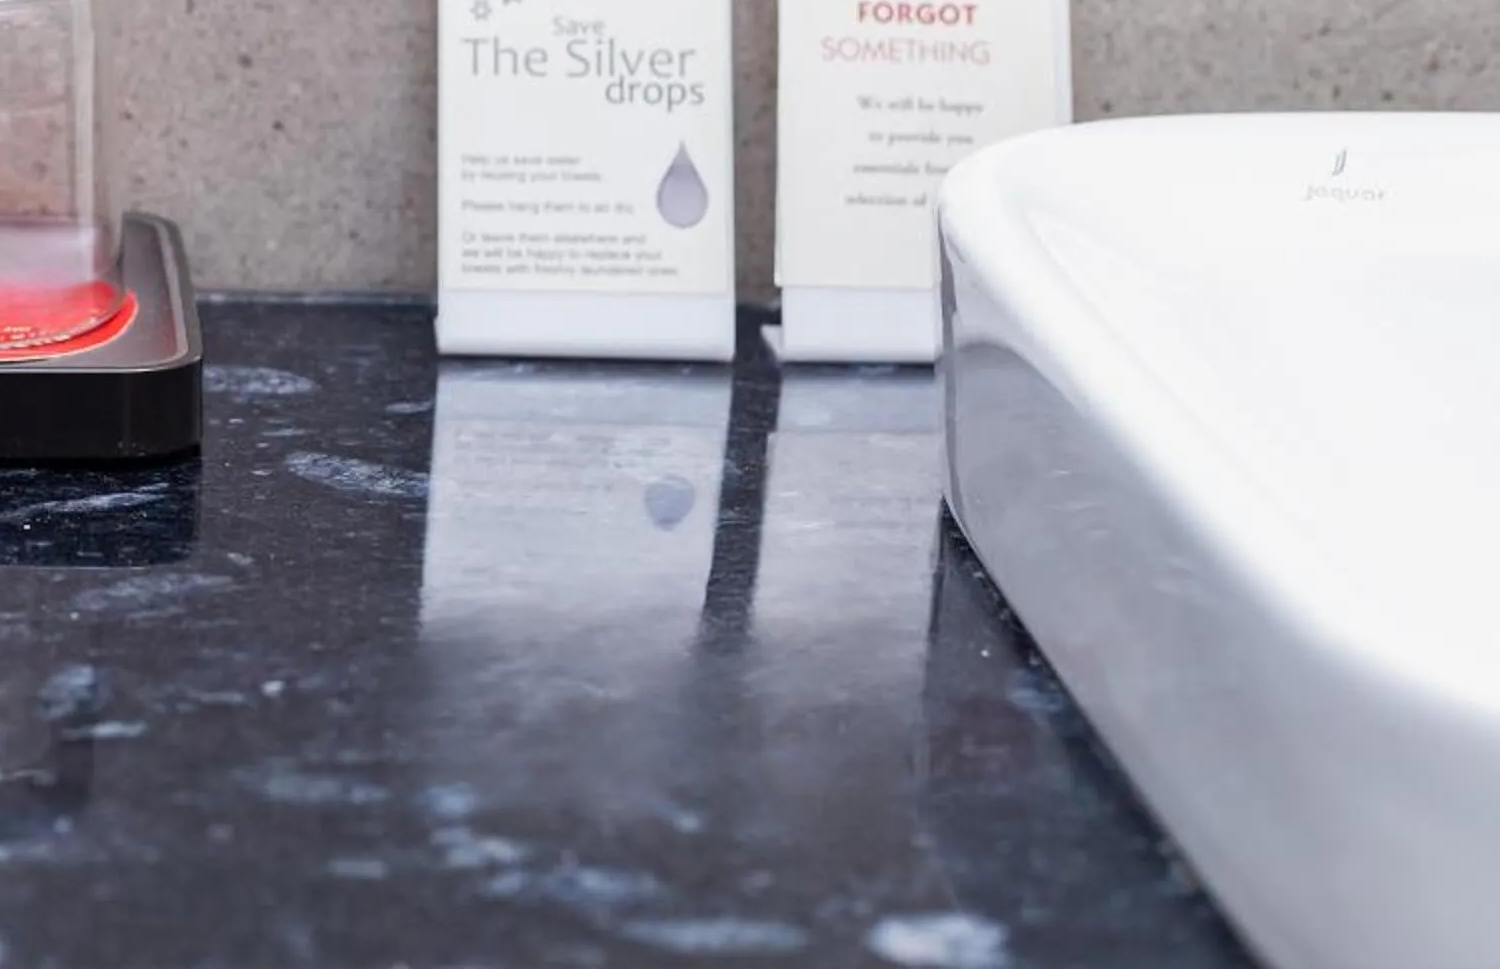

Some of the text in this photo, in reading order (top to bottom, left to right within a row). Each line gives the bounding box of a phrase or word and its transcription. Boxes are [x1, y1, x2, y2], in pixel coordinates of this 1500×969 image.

[552, 15, 605, 36] Save
[857, 1, 979, 26] FORGOT
[462, 37, 697, 78] The Silver
[820, 36, 992, 65] SOMETHING
[605, 74, 706, 112] drops
[856, 95, 984, 119] We will be happy
[868, 131, 883, 143] to
[887, 128, 942, 148] provide
[924, 160, 949, 178] fro
